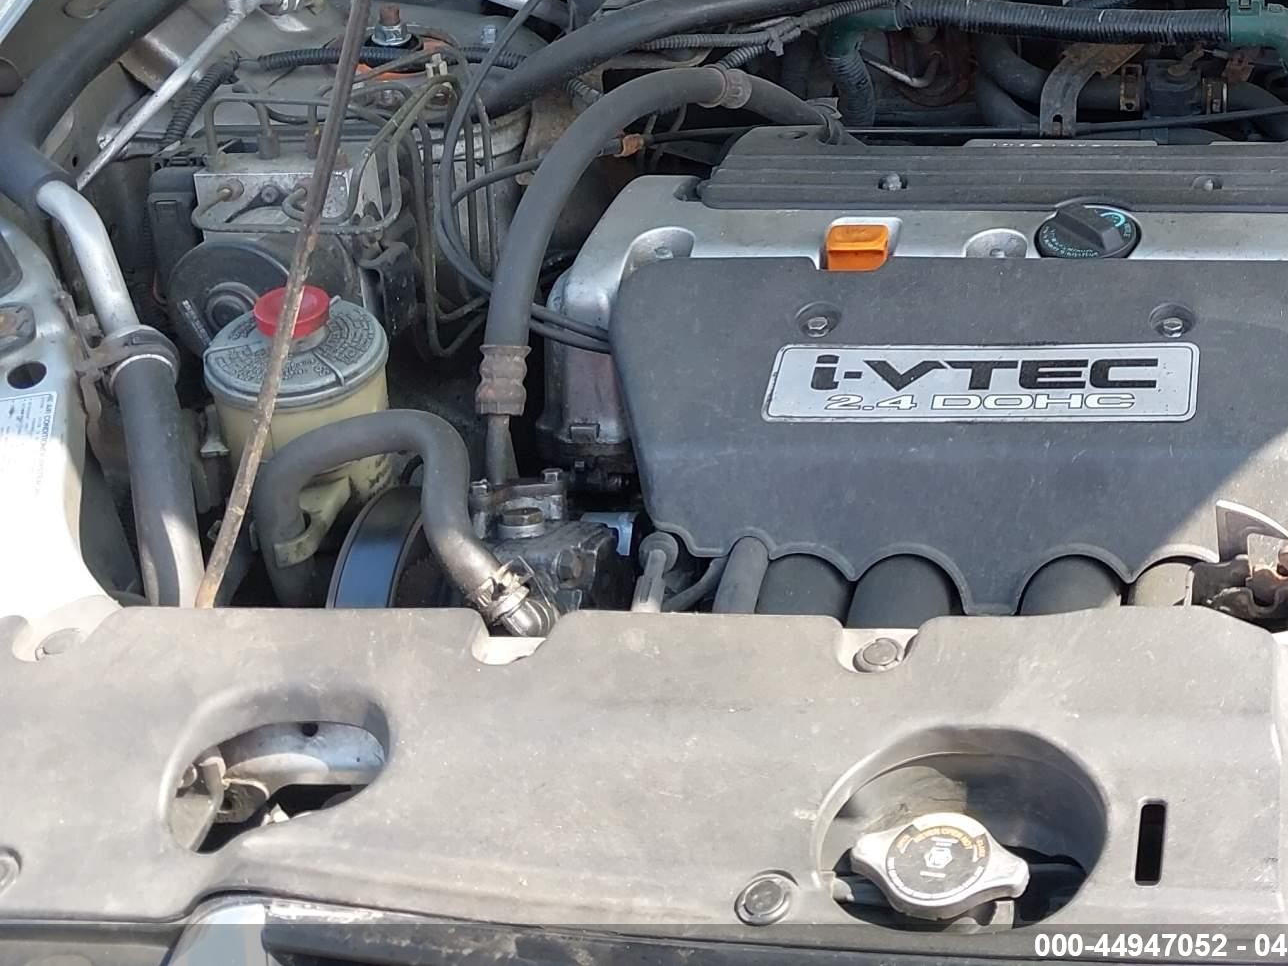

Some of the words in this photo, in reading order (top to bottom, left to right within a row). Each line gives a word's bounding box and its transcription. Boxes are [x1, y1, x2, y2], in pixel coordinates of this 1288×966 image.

[810, 354, 1159, 391] i-VTEC
[824, 393, 917, 411] 2.4
[930, 393, 1136, 410] DOHC
